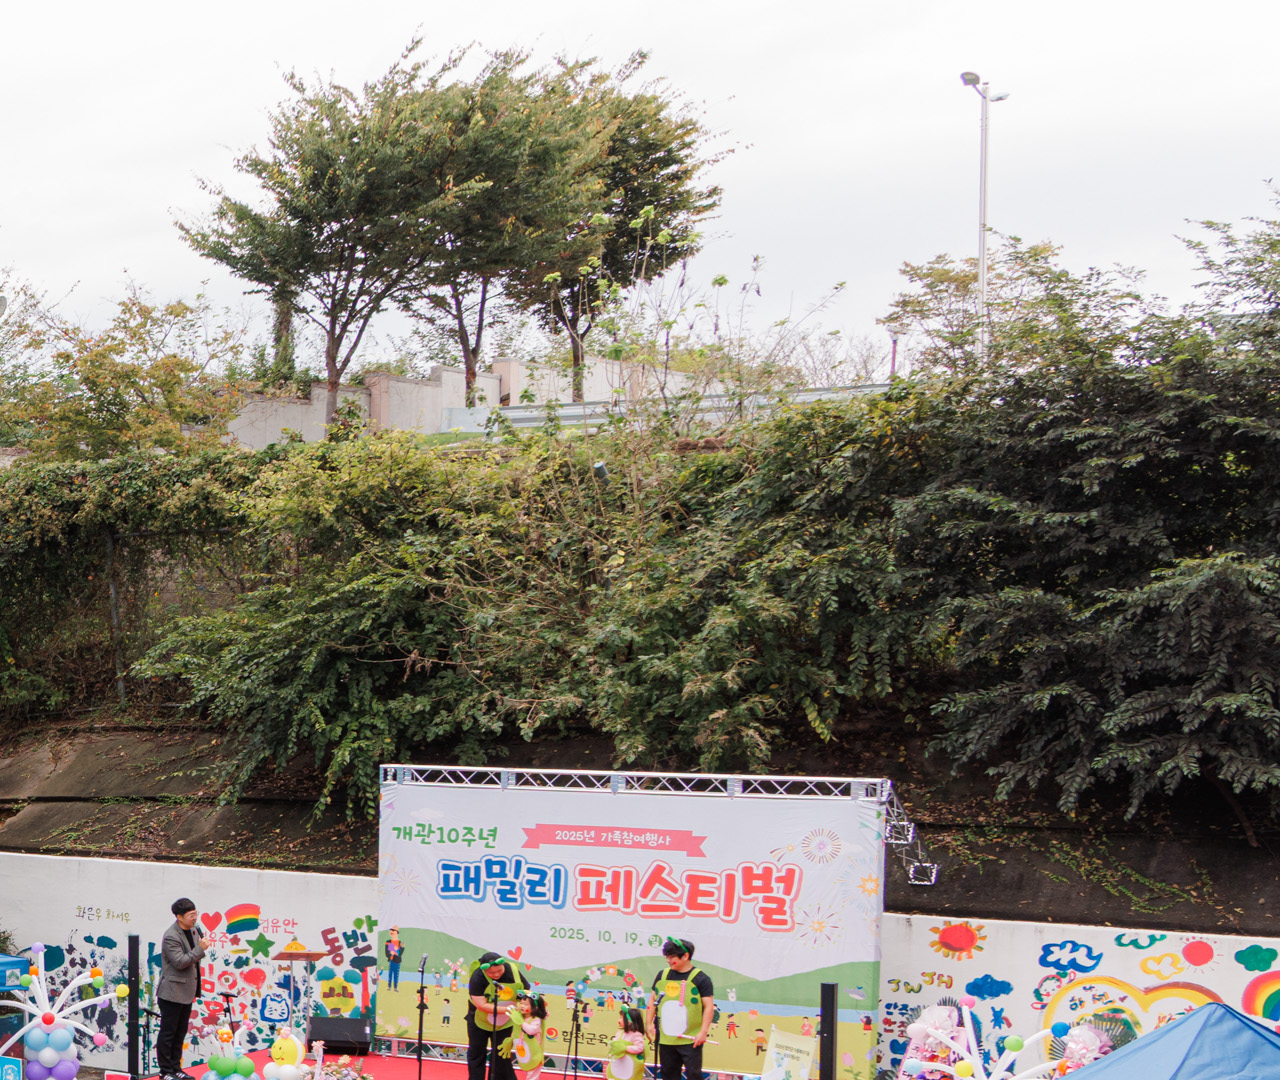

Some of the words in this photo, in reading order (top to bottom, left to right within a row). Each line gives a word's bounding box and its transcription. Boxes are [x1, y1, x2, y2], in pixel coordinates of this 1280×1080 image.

[392, 822, 498, 849] 개관10주년
[555, 830, 595, 843] 2025년
[601, 830, 672, 847] 가족참여행사
[438, 855, 568, 910] 패밀리
[573, 860, 803, 932] 페스티벌
[550, 926, 590, 942] 2025.
